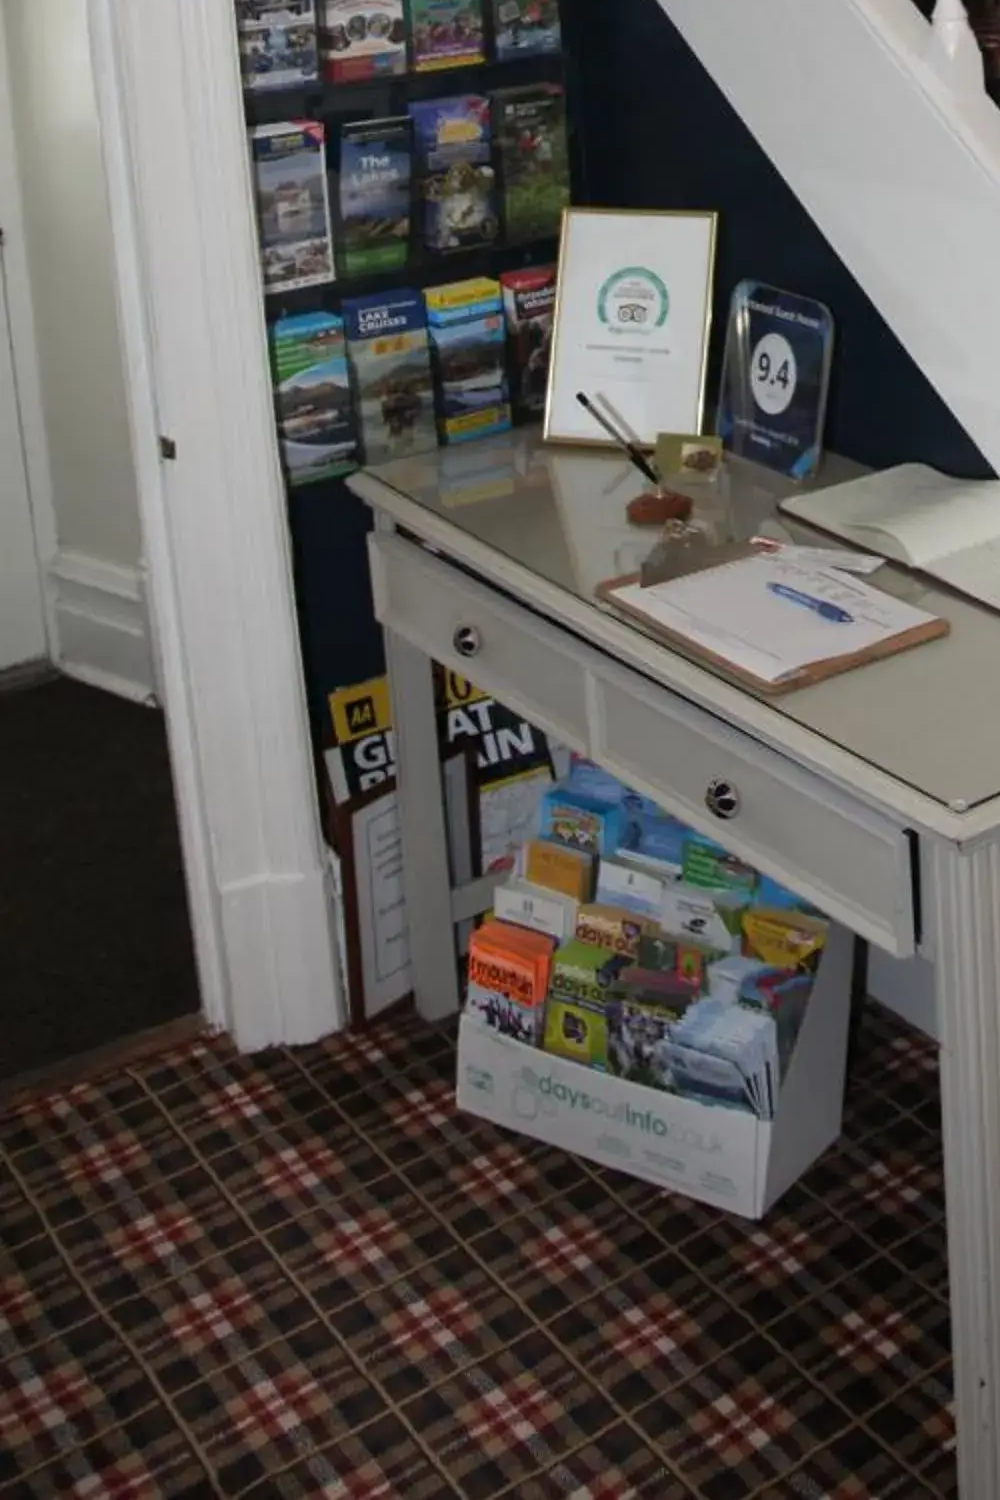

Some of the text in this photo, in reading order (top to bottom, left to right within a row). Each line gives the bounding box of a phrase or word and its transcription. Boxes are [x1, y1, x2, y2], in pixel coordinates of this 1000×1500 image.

[360, 154, 390, 169] The
[757, 351, 790, 390] 9.4
[350, 703, 372, 727] AA
